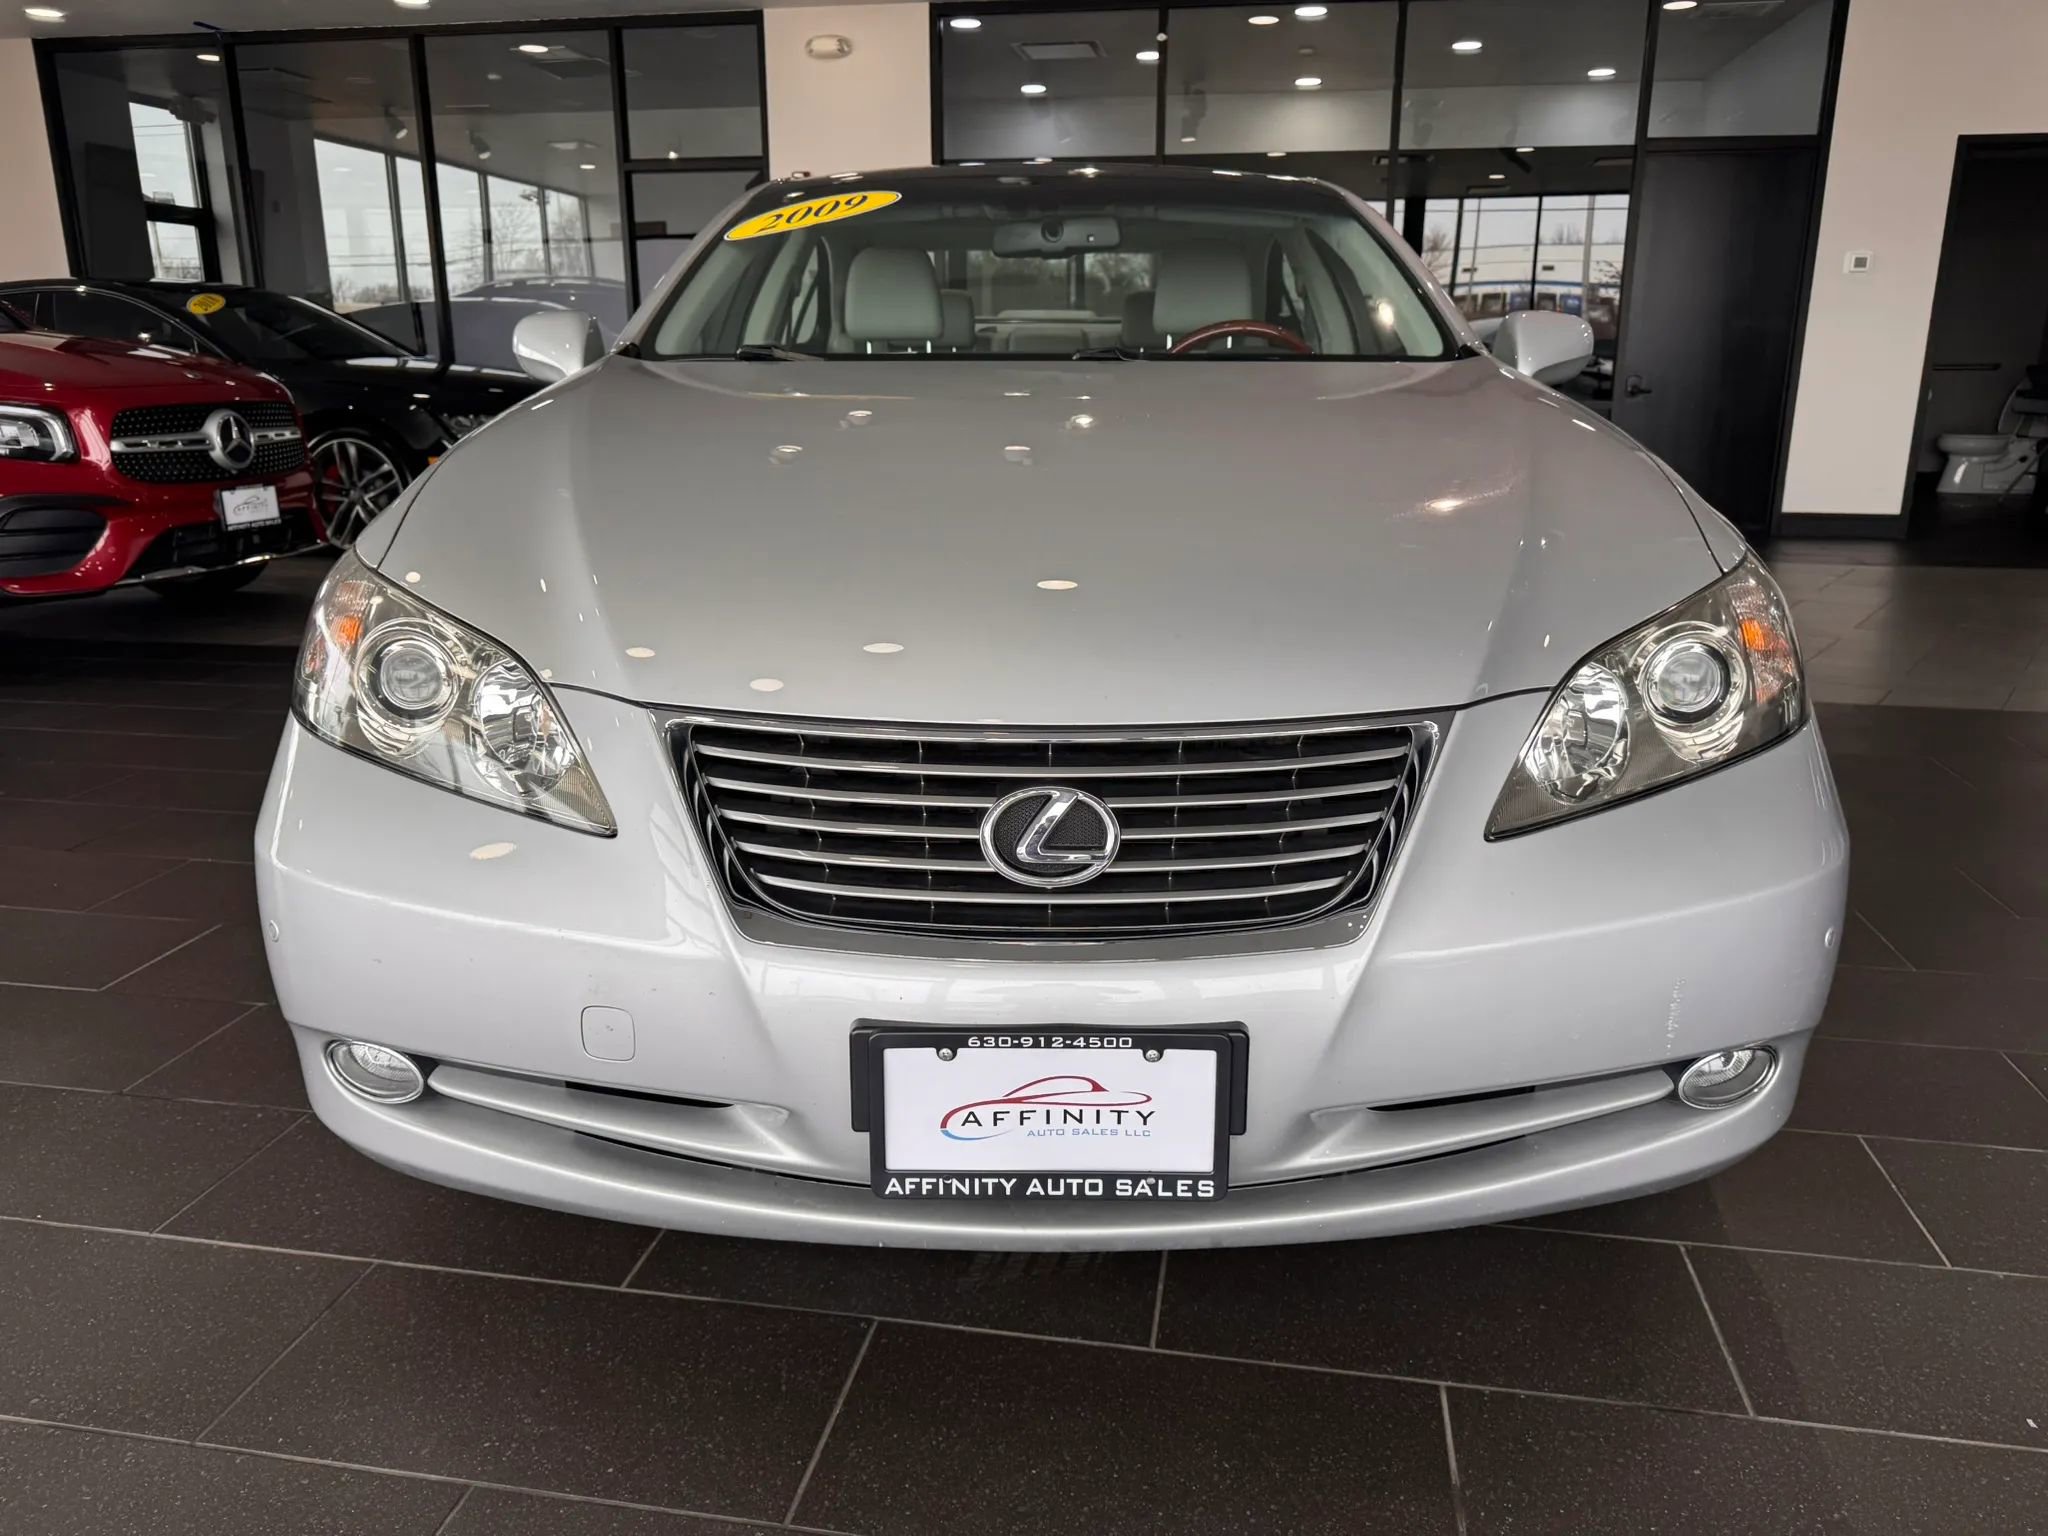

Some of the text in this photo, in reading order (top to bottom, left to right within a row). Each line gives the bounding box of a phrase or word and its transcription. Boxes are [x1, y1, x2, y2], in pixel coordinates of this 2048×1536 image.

[754, 194, 869, 234] 2009
[967, 1036, 1133, 1048] 630-912-4500
[961, 1109, 1156, 1127] AFFINITY
[1026, 1128, 1151, 1137] AUTO SALES LLC
[885, 1177, 1214, 1197] AFFINITY AUTO SALES
